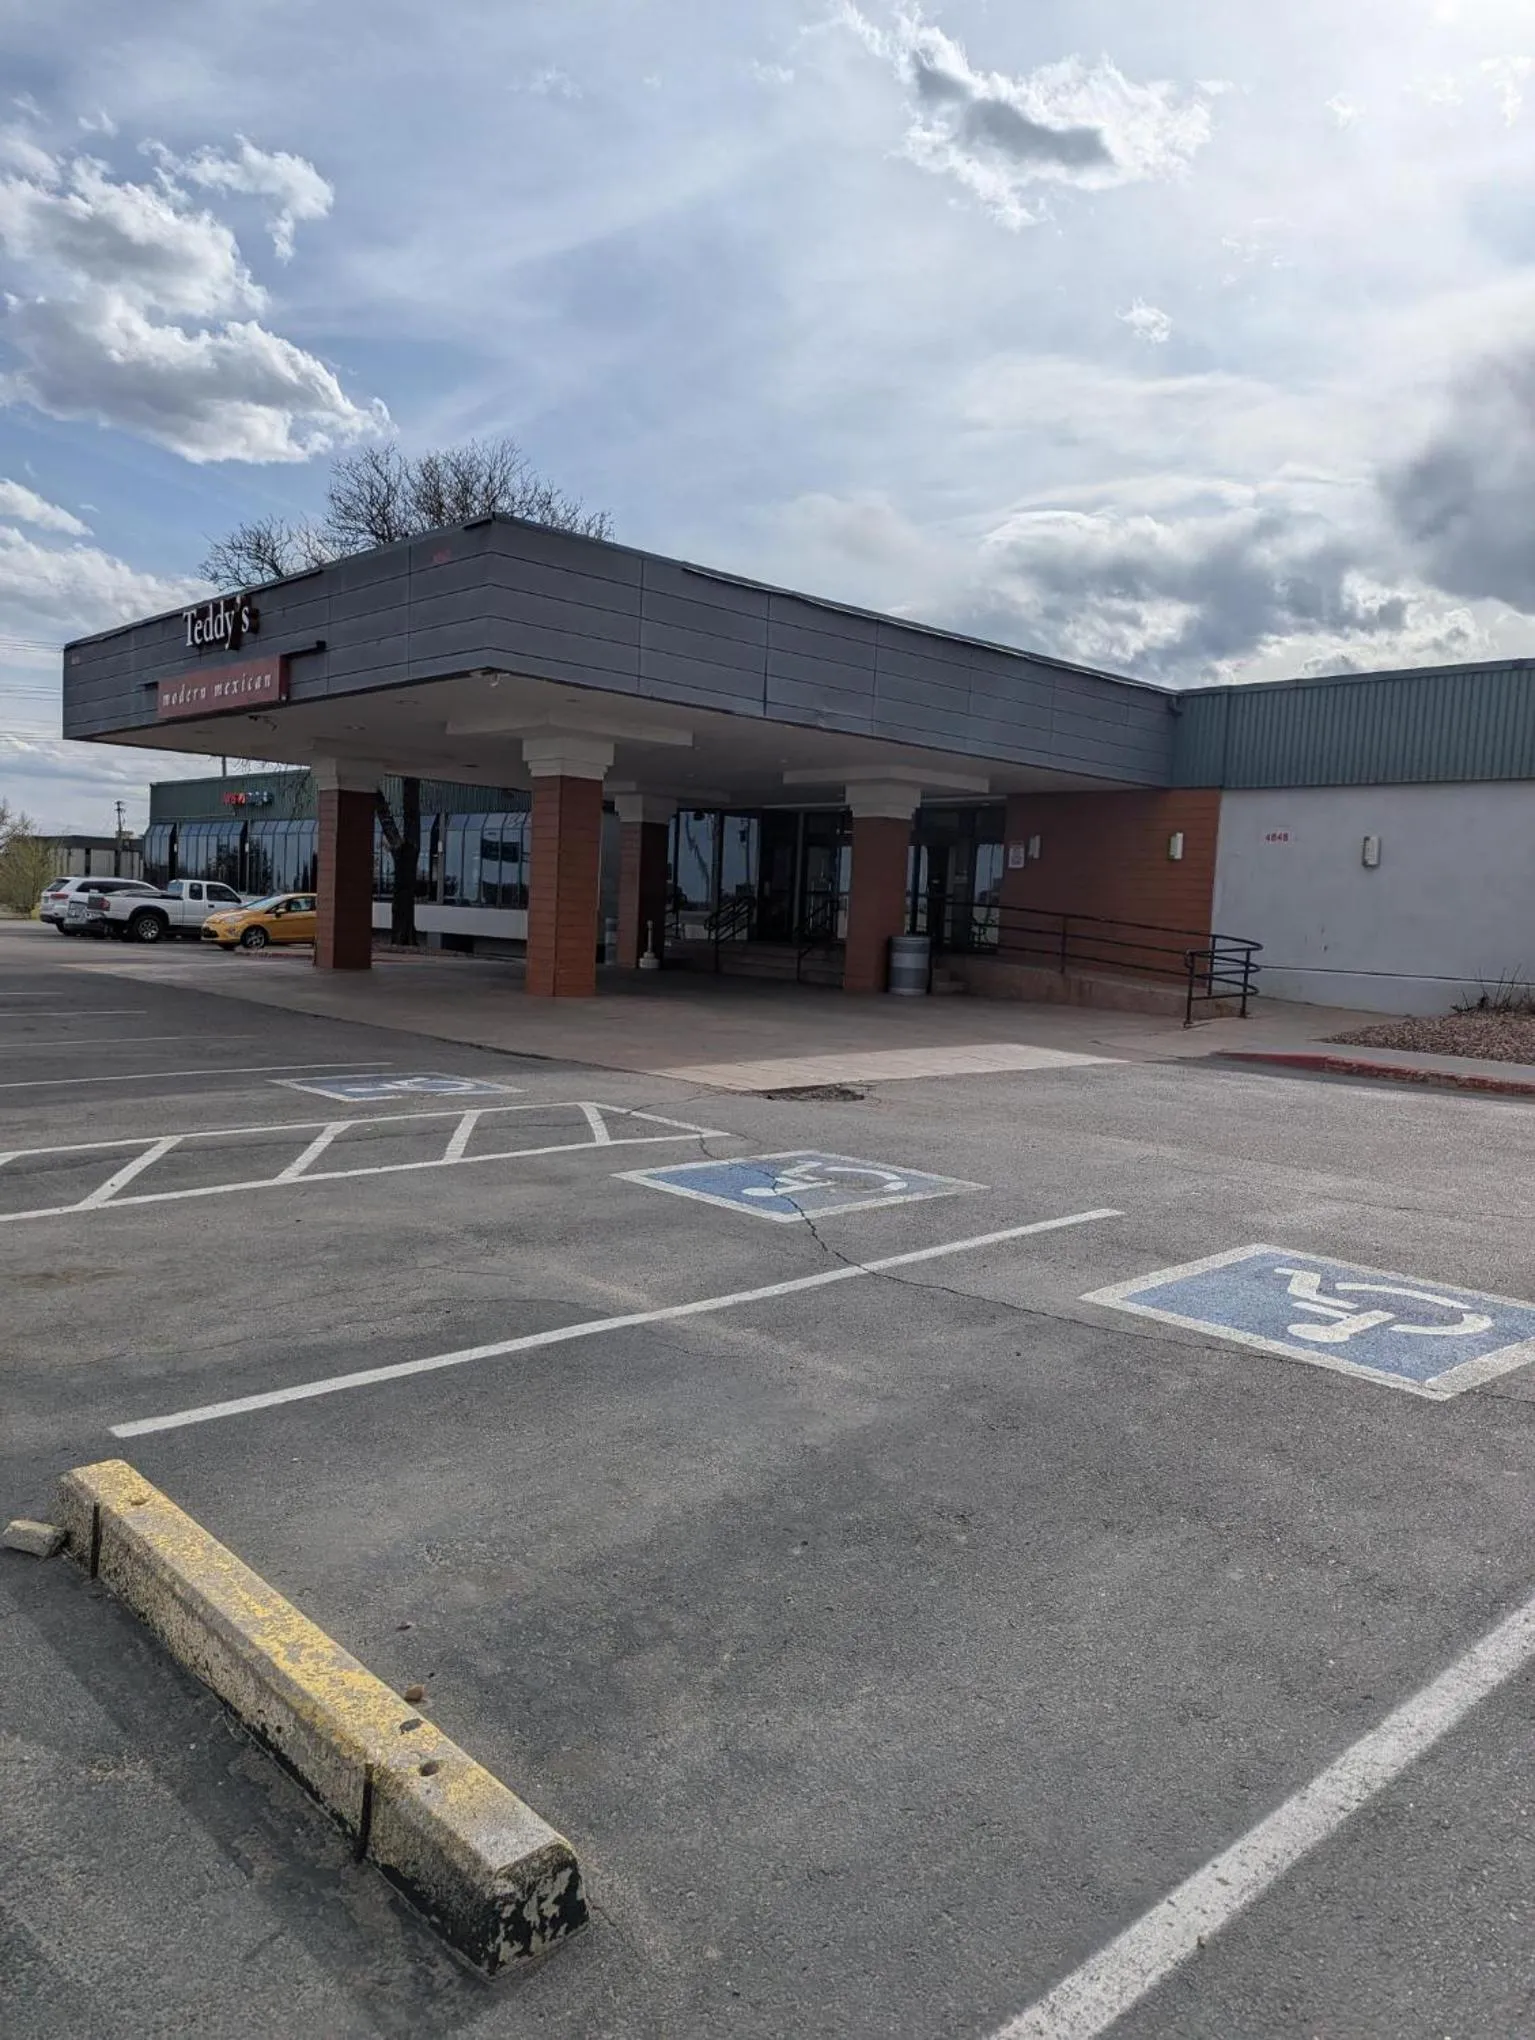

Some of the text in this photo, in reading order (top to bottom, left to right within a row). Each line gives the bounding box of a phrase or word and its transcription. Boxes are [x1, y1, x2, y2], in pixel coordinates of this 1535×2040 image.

[182, 594, 250, 650] Teddy's
[162, 673, 272, 706] modern mexican
